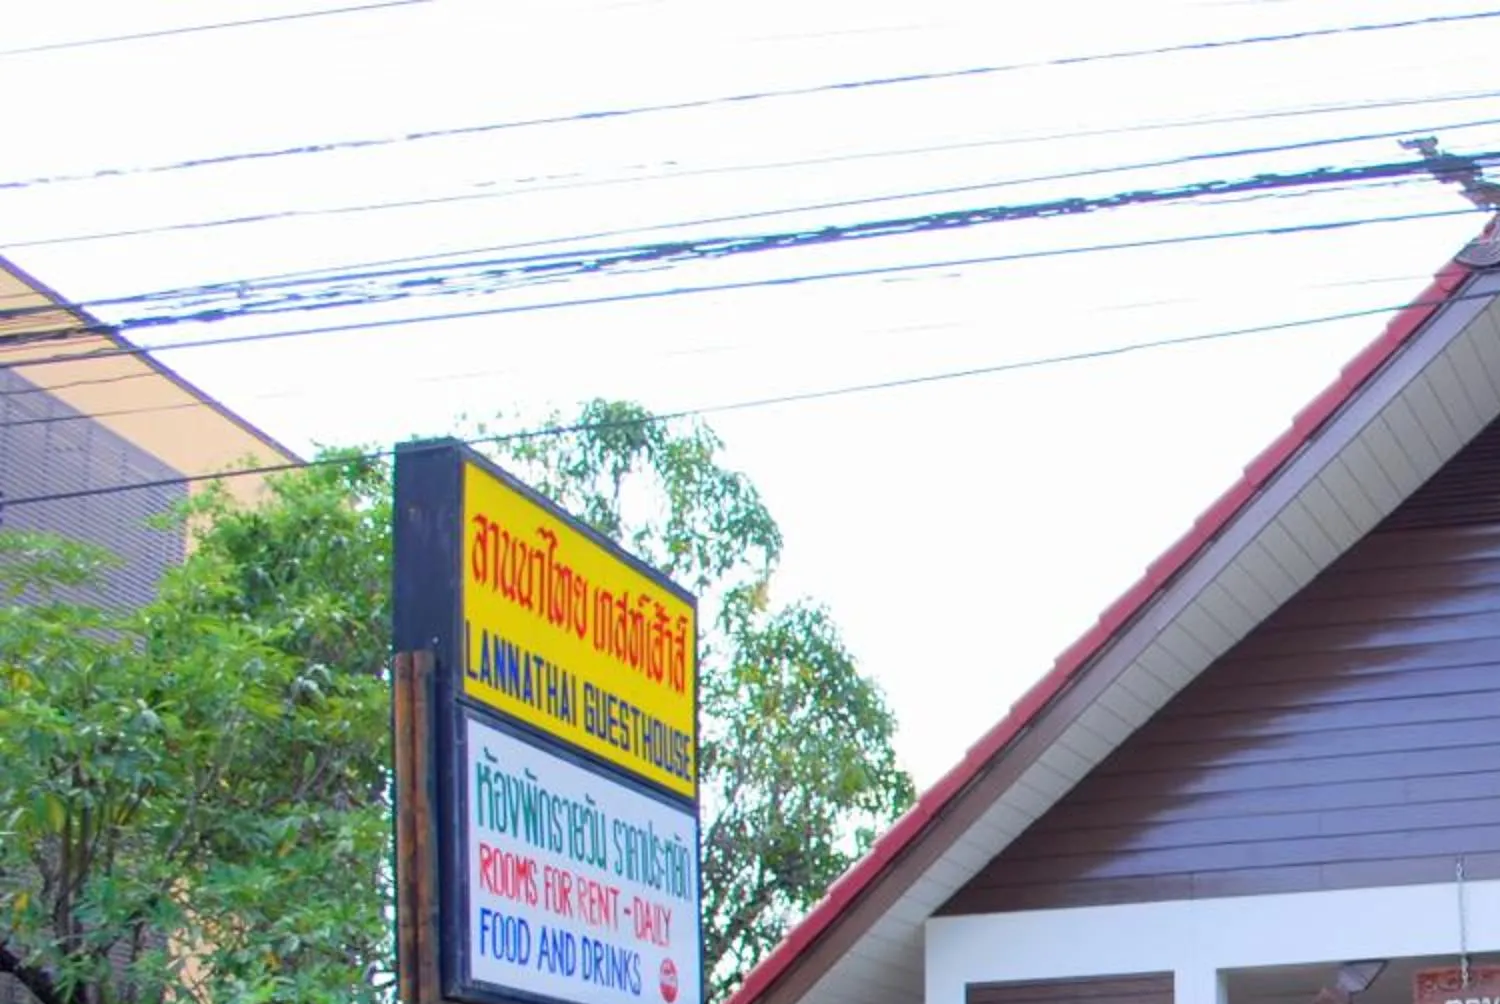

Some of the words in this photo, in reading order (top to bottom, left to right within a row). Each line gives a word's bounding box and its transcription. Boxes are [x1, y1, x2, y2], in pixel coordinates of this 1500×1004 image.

[465, 620, 577, 727] LANNATHAI
[583, 681, 692, 781] GUESTHOUSE
[476, 747, 606, 871] ห้องพักรายวัน
[613, 818, 693, 901] ราคาประหยัด
[479, 843, 538, 905] ROOMS
[544, 866, 574, 915] FOR
[480, 907, 531, 965] FOOD
[537, 925, 576, 976] AND
[582, 937, 642, 996] DRINKS
